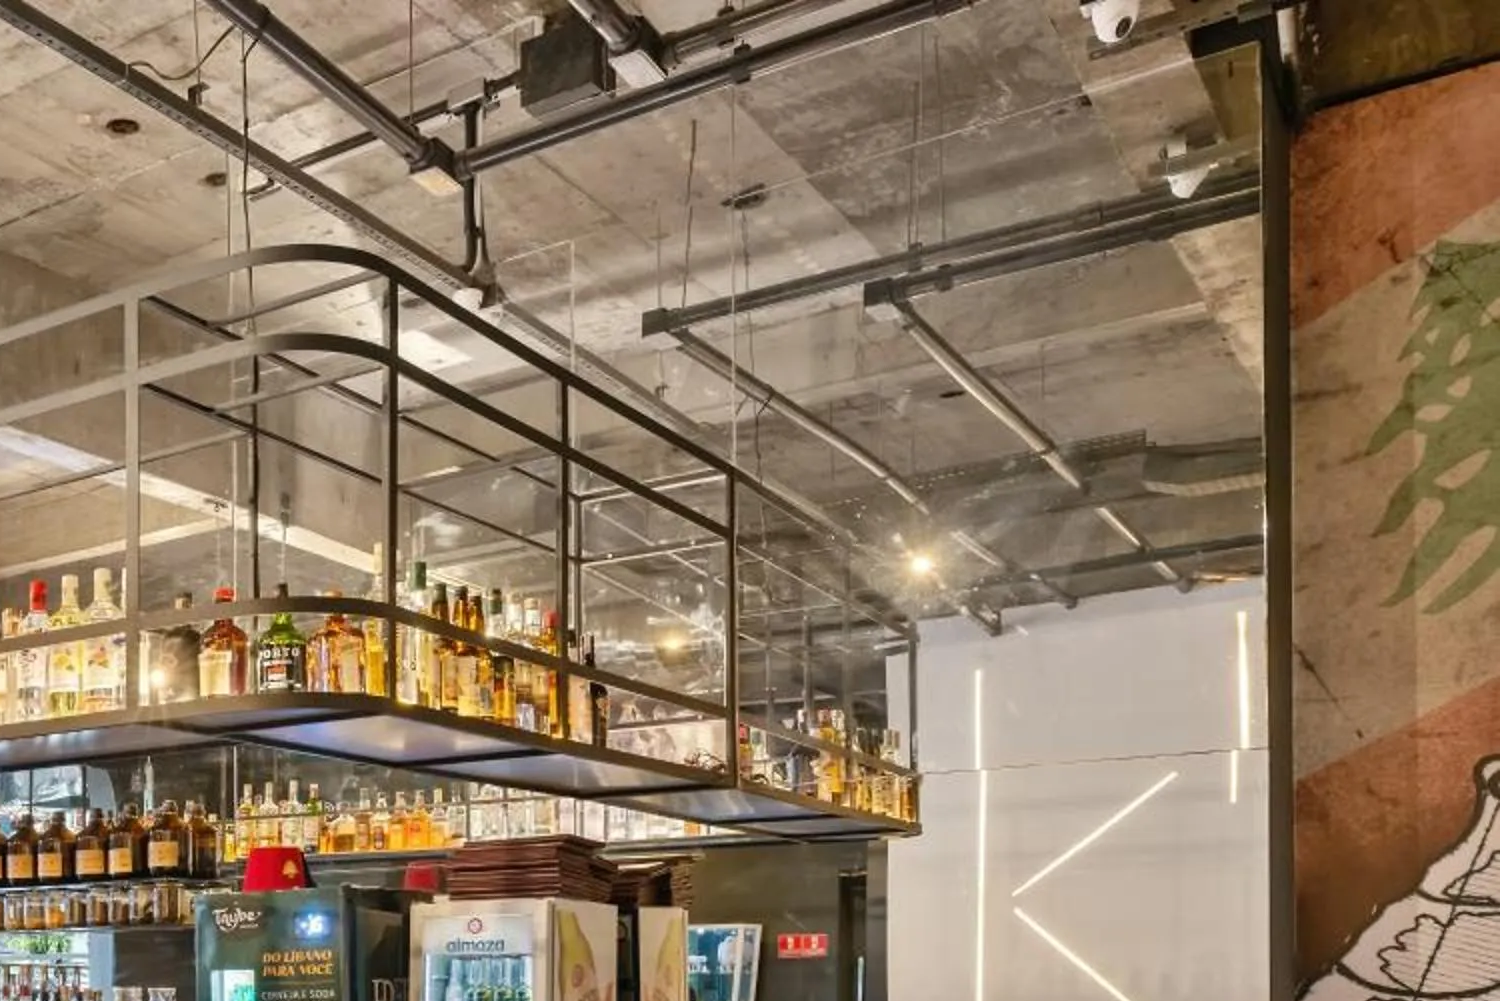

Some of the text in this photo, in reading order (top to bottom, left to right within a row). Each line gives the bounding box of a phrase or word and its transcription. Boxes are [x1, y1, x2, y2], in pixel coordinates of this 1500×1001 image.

[446, 939, 505, 953] almaza
[263, 952, 281, 963] DO
[263, 965, 295, 977] PARA
